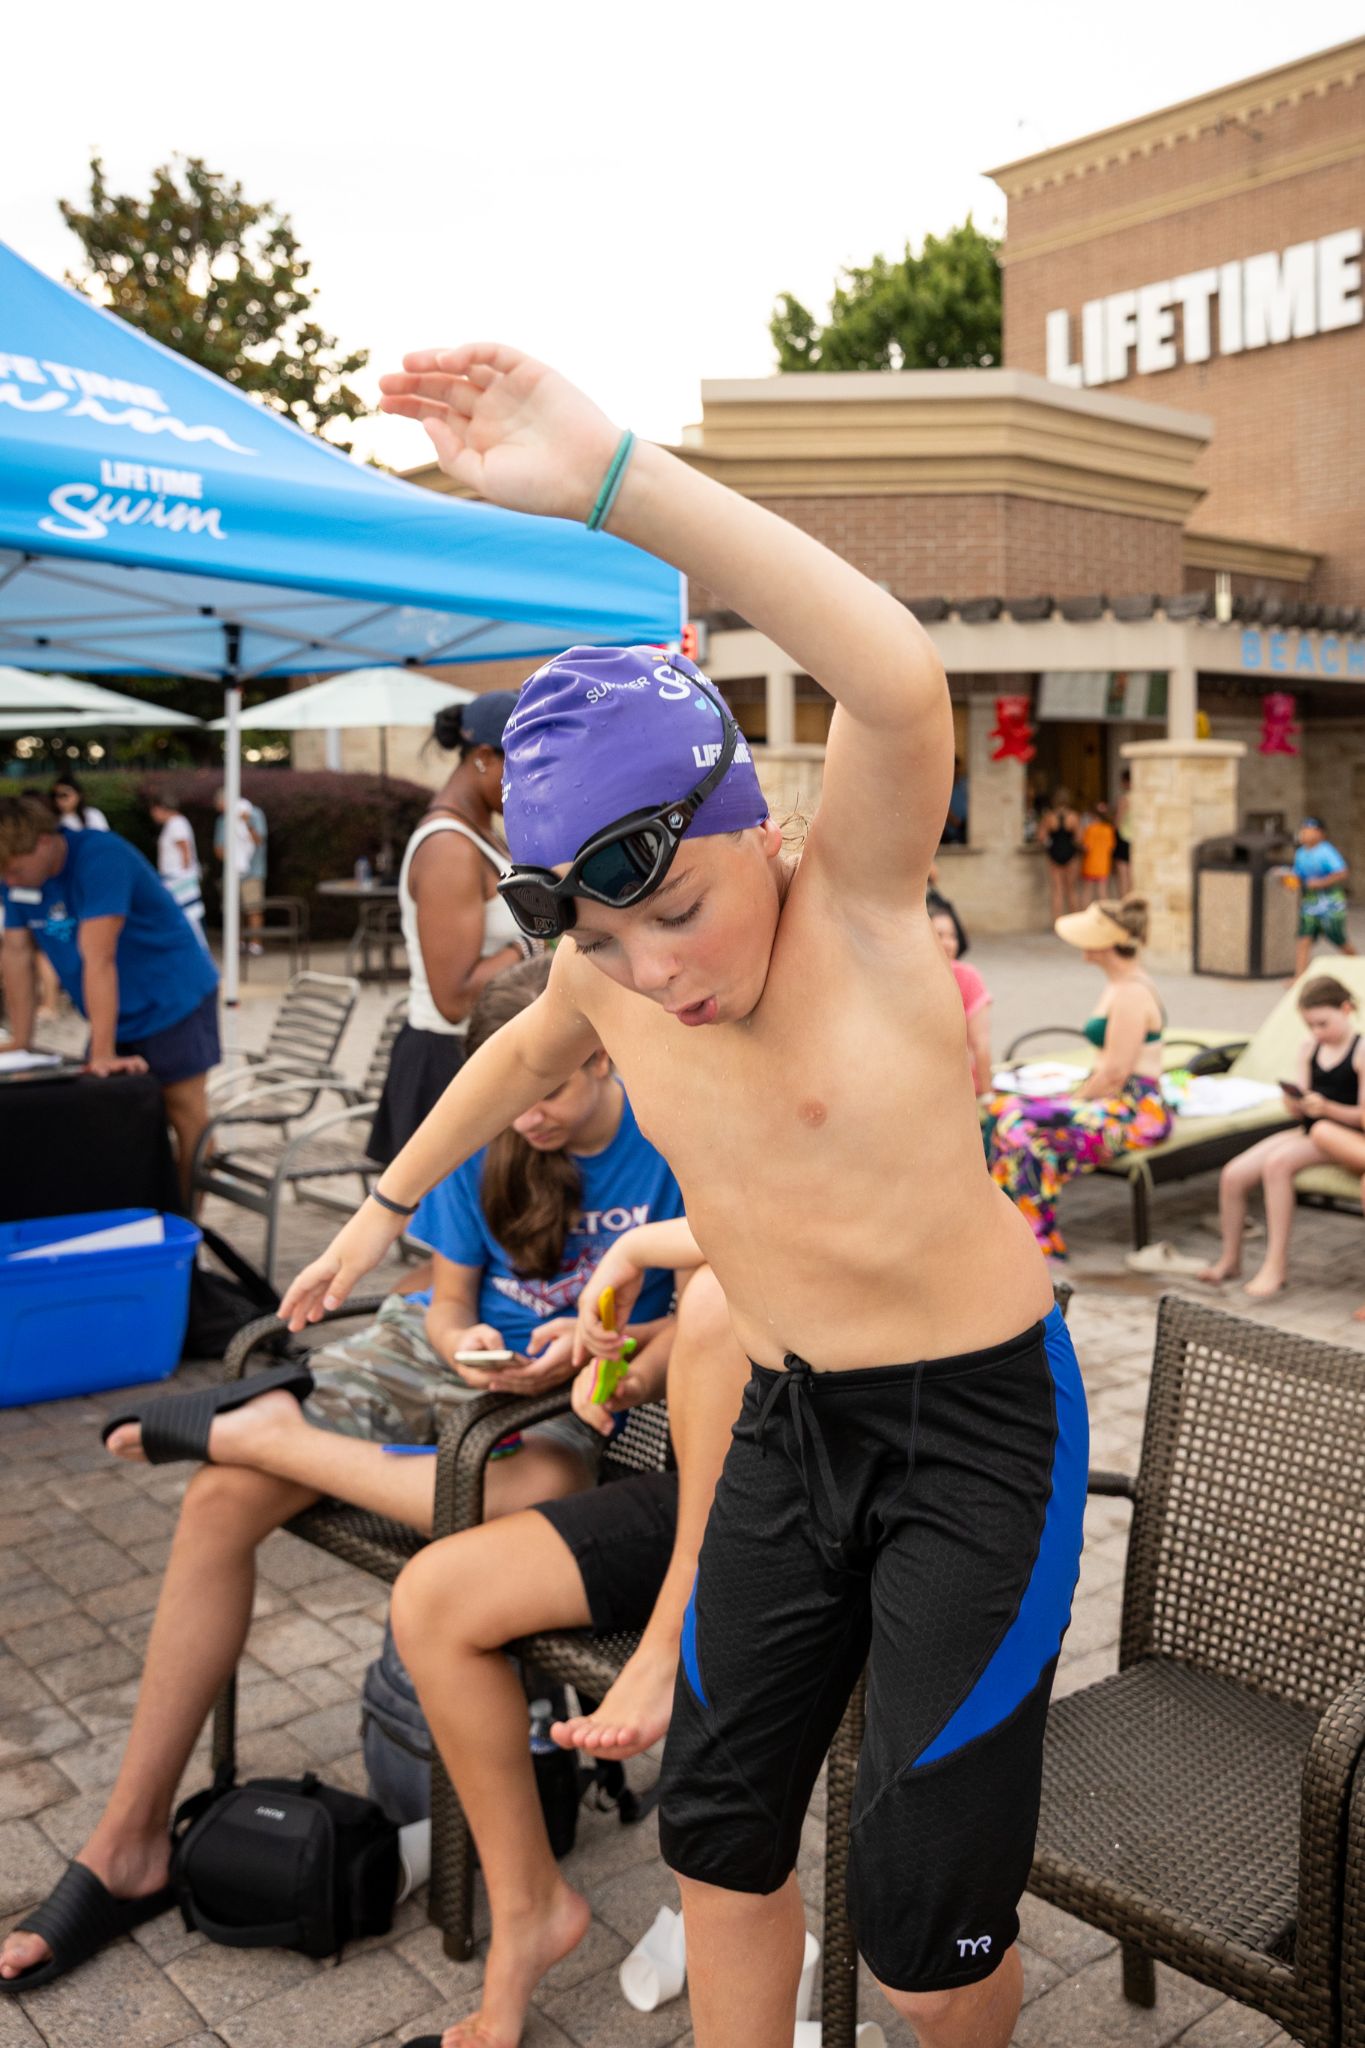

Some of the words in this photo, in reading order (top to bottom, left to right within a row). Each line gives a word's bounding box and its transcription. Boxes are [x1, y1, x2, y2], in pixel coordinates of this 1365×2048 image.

[1046, 227, 1364, 390] LIFETIME
[37, 482, 228, 540] Swim
[957, 1935, 992, 1958] TYR
